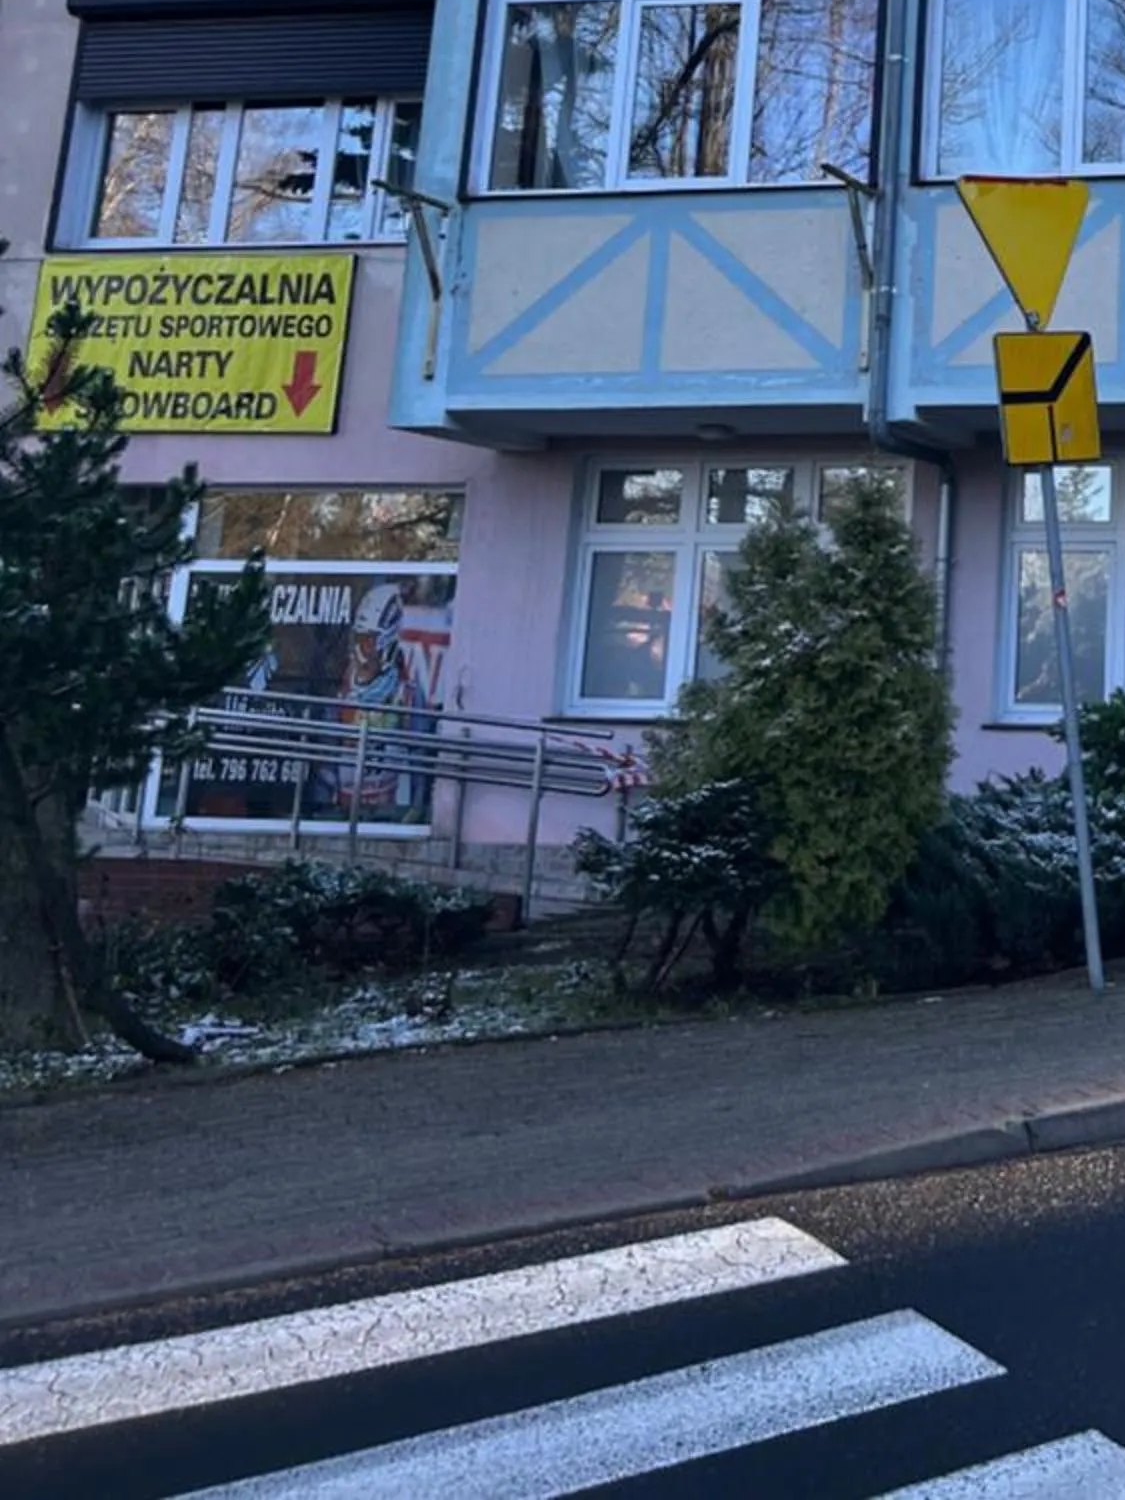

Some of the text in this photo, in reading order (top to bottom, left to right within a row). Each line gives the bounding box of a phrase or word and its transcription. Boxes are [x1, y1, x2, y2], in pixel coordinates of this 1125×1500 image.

[51, 266, 336, 305] WYPOŻYCZALNIA
[159, 314, 333, 339] SPORTOWEGO
[128, 350, 233, 378] NARTY
